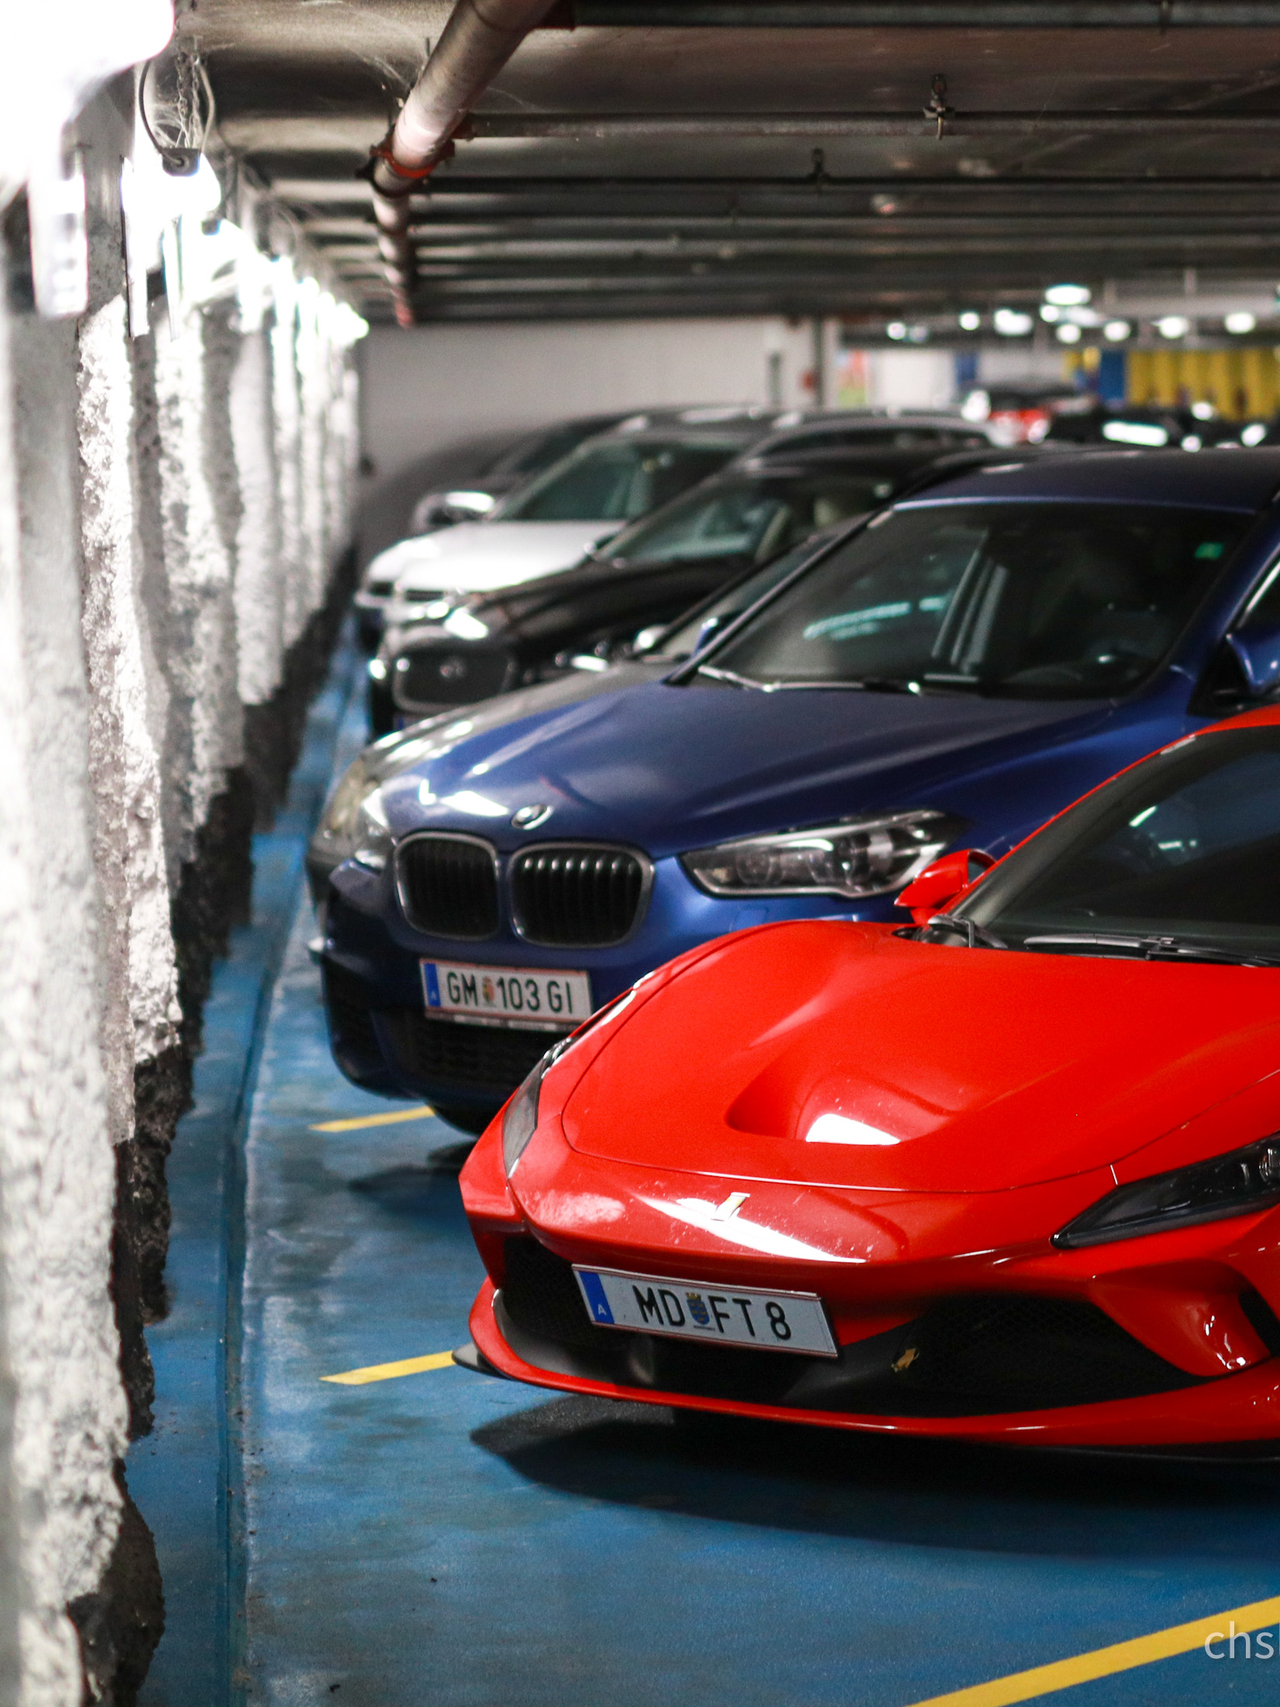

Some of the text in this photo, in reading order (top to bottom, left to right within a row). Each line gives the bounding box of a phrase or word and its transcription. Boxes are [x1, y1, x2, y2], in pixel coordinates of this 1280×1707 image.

[447, 971, 573, 1014] GM 103 GI
[597, 1303, 607, 1316] A
[632, 1284, 792, 1341] MD FT 8
